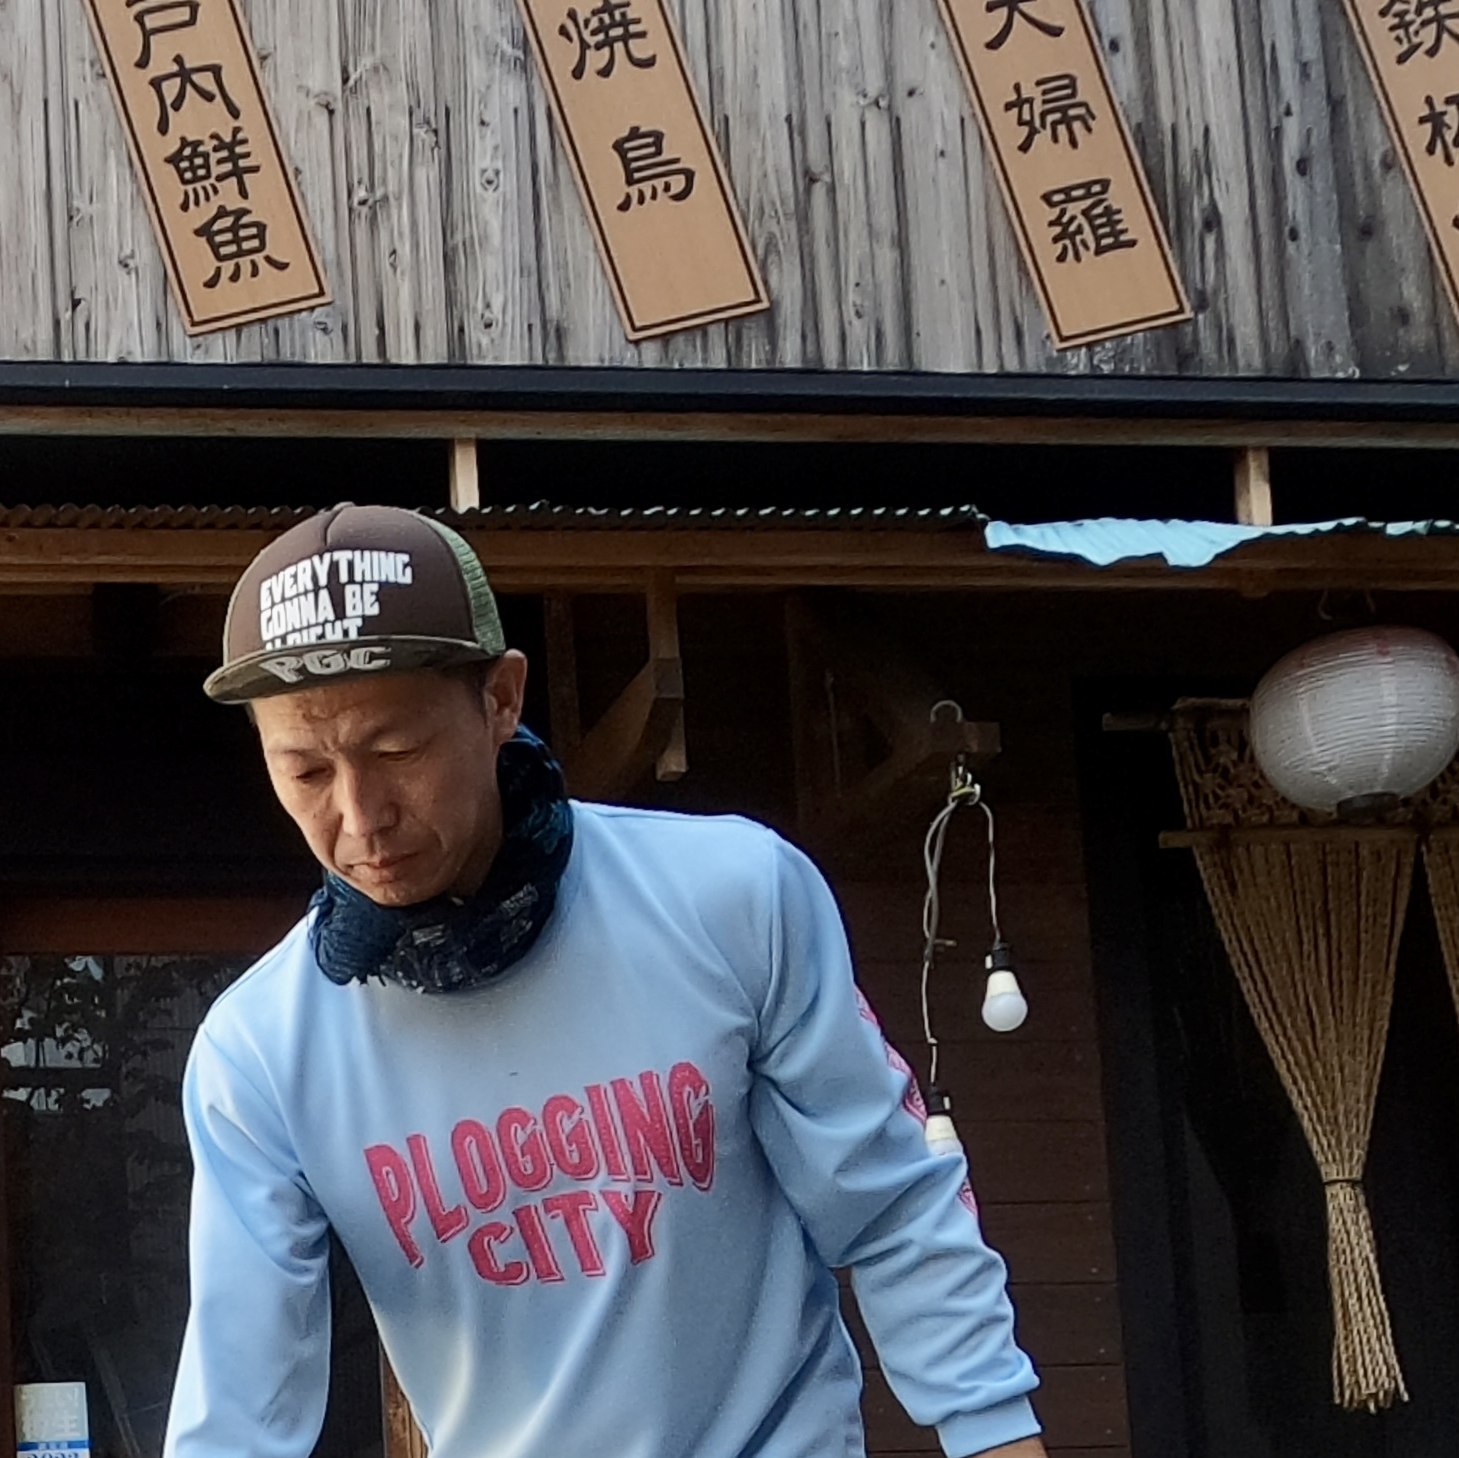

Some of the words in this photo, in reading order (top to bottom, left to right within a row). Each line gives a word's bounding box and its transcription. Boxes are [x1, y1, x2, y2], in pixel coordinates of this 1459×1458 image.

[125, 0, 290, 289] 戸内鮮魚
[558, 0, 697, 213] 焼鳥
[260, 550, 413, 611] EVERYTHING
[260, 588, 336, 642] GONNA
[344, 583, 380, 618] BE
[259, 646, 392, 683] PGC
[364, 1062, 715, 1269] PLOGGING
[467, 1189, 663, 1286] CITY
